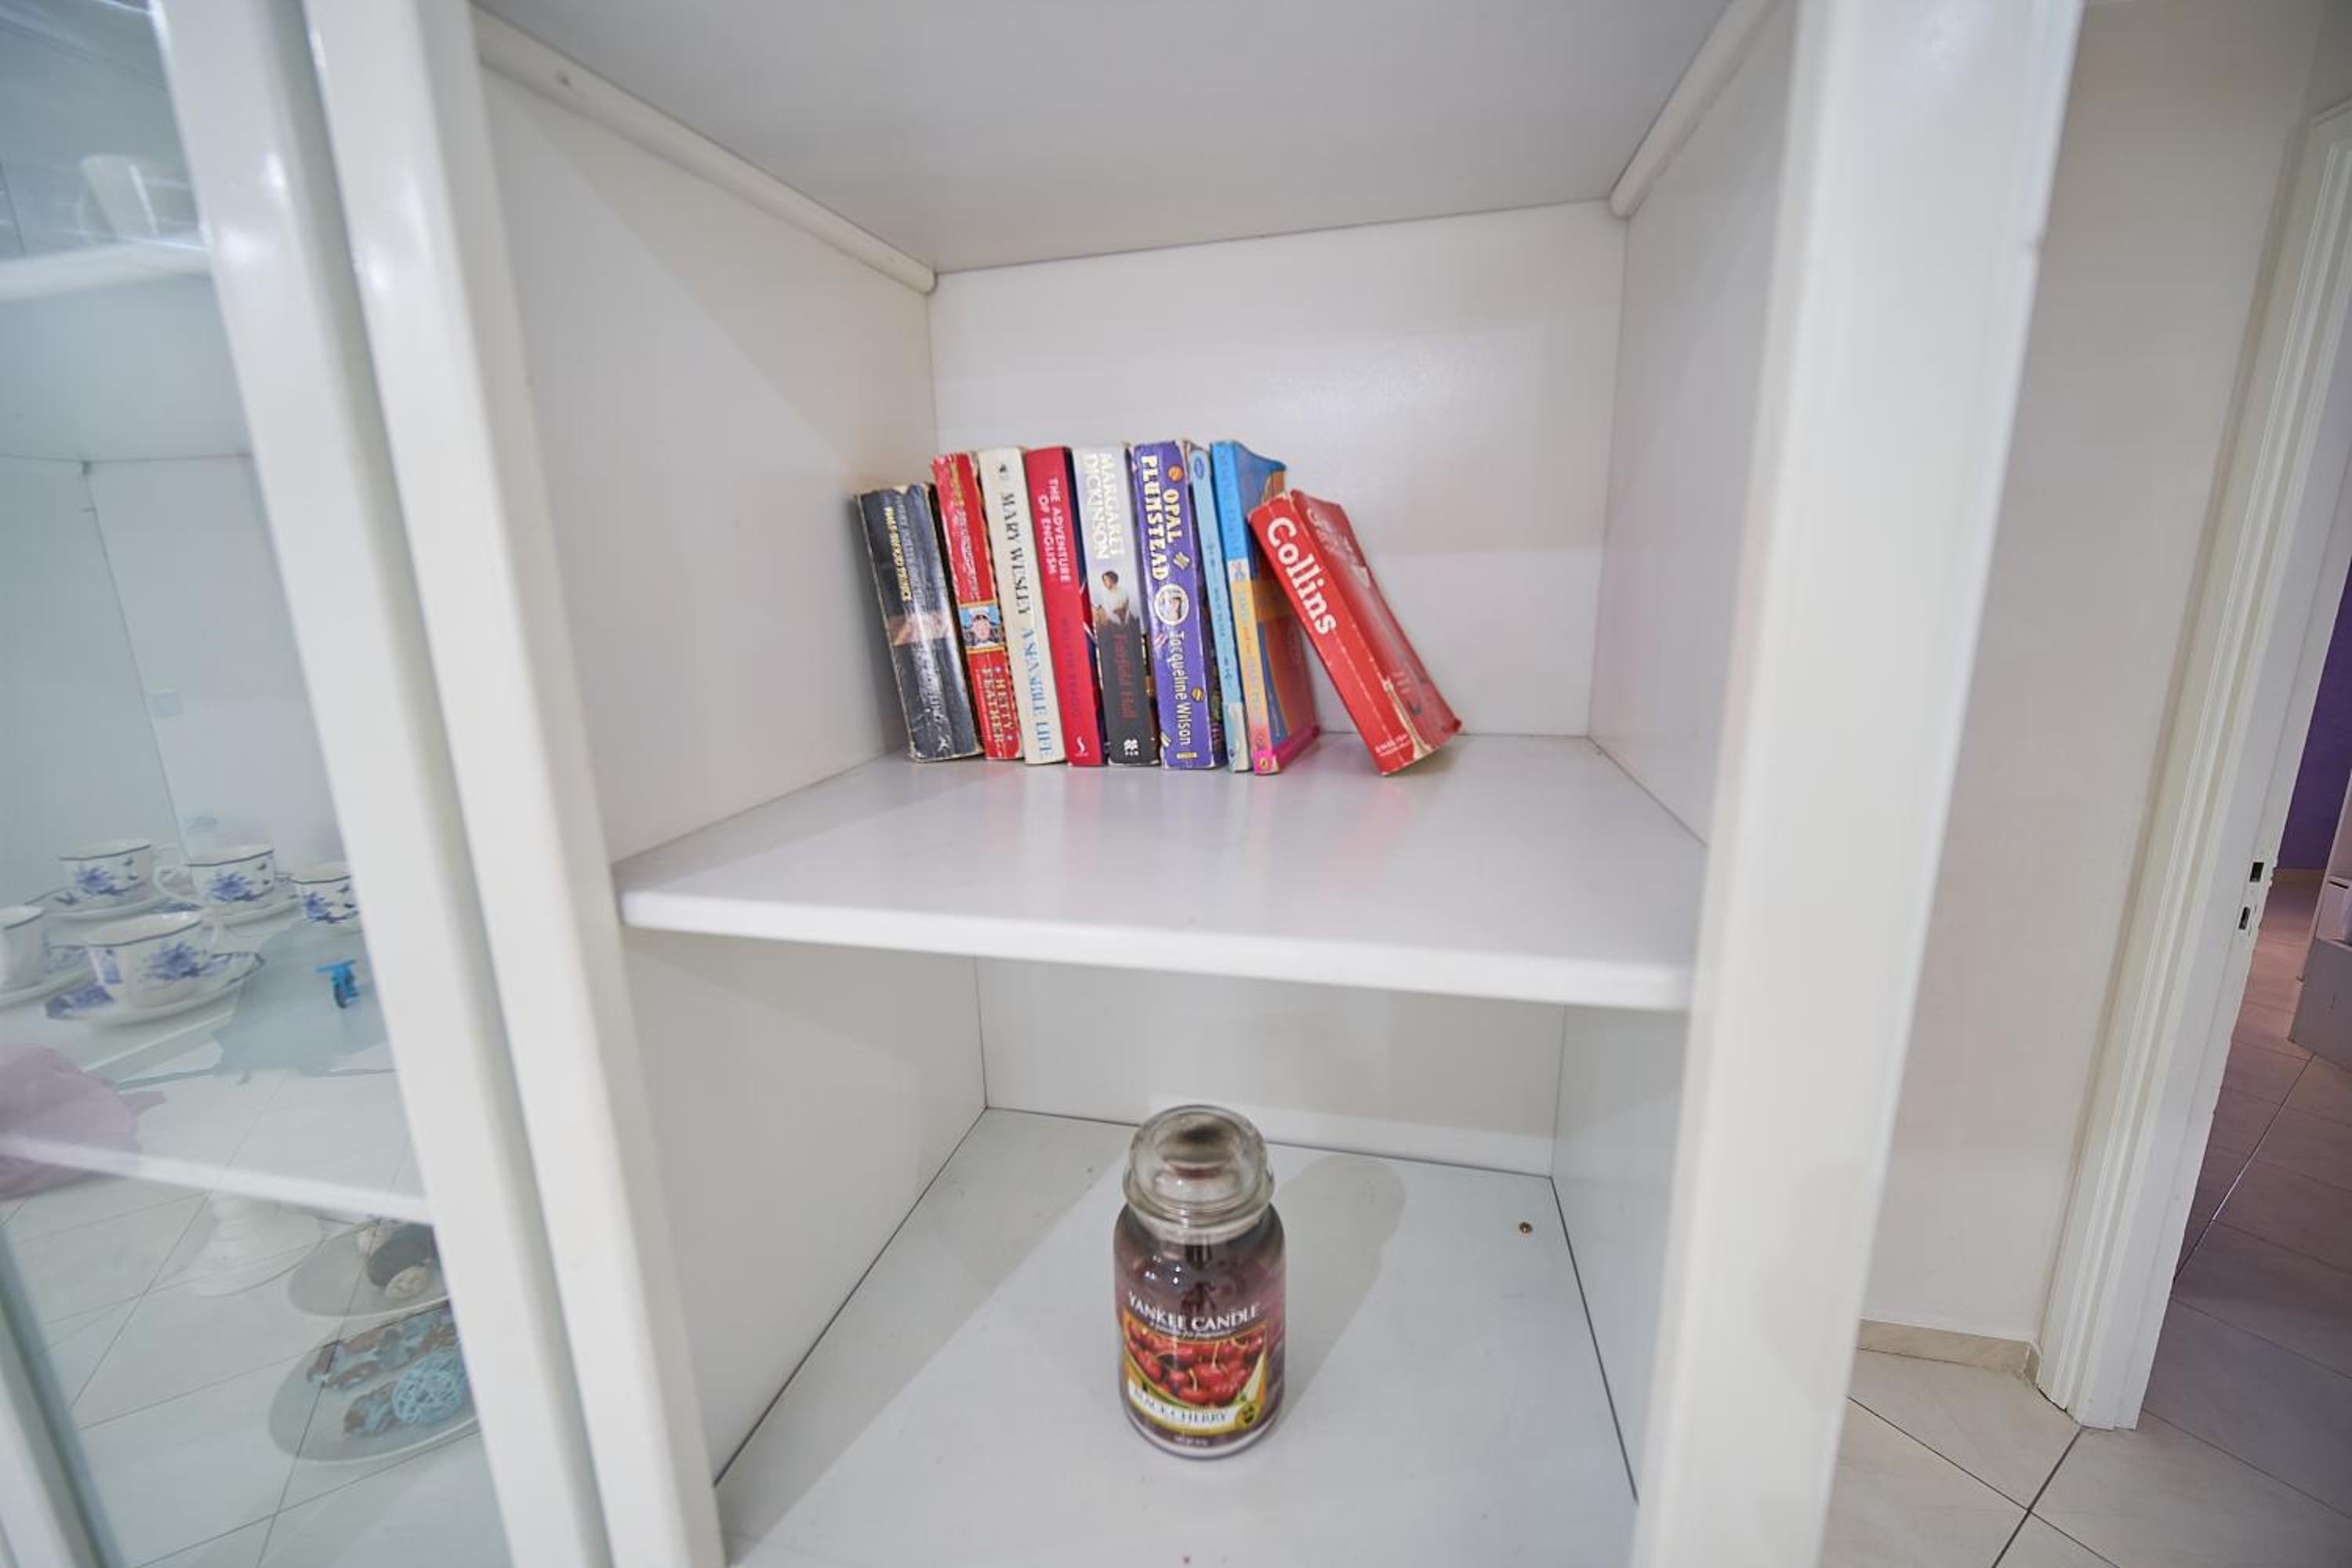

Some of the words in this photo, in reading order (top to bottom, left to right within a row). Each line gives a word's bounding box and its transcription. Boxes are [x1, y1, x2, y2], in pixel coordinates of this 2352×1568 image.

[1000, 493, 1020, 543] MARY
[1039, 495, 1051, 515] OF
[1048, 478, 1062, 505] THE
[1084, 453, 1109, 560] DICKINSON
[1098, 453, 1125, 557] MARGARET
[1142, 455, 1167, 581] PLUMSTEAD
[1163, 489, 1182, 543] OPAL
[1040, 518, 1057, 575] ENGLISH
[1052, 508, 1071, 583] ADVENTURE
[1009, 549, 1030, 616] WESLEY
[1267, 517, 1336, 635] Collins
[1166, 631, 1189, 700] Jacqueline
[981, 666, 1004, 745] FEATHER
[994, 677, 1014, 731] HETTY
[1119, 691, 1136, 720] Hall
[1177, 703, 1192, 746] Wilson
[1036, 722, 1054, 757] LIFE
[1129, 1292, 1187, 1328] YANKEE
[1192, 1304, 1256, 1330] CANDLE
